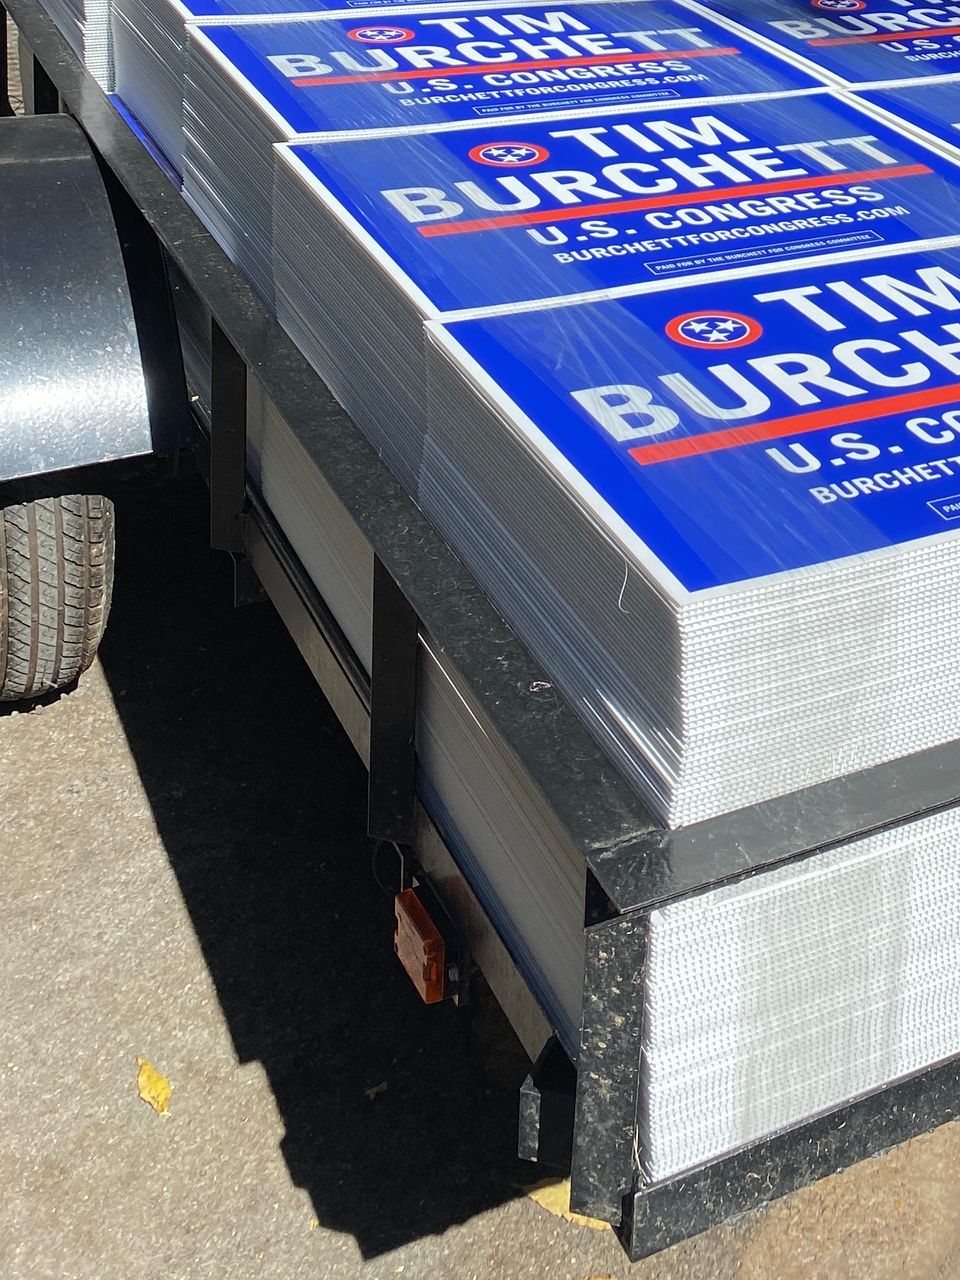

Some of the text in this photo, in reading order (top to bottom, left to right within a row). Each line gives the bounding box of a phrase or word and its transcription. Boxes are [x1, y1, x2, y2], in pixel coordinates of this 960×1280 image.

[419, 12, 589, 38] TIM
[266, 27, 713, 78] BURCHETT
[878, 39, 952, 52] U.S.
[381, 61, 691, 93] U.S. CONGRESS
[399, 74, 710, 105] BURCHETTFORCONGRESS.COM
[549, 116, 749, 157] TIM
[380, 136, 898, 224] BURCHETT
[526, 186, 884, 245] U.S. CONGRESS
[553, 206, 911, 263] BURCHETTFORCONGRESS.COM
[655, 263, 676, 271] PAID
[725, 249, 768, 259] BURCHETT
[786, 241, 826, 250] CONGRESS
[765, 433, 903, 473] U.S.
